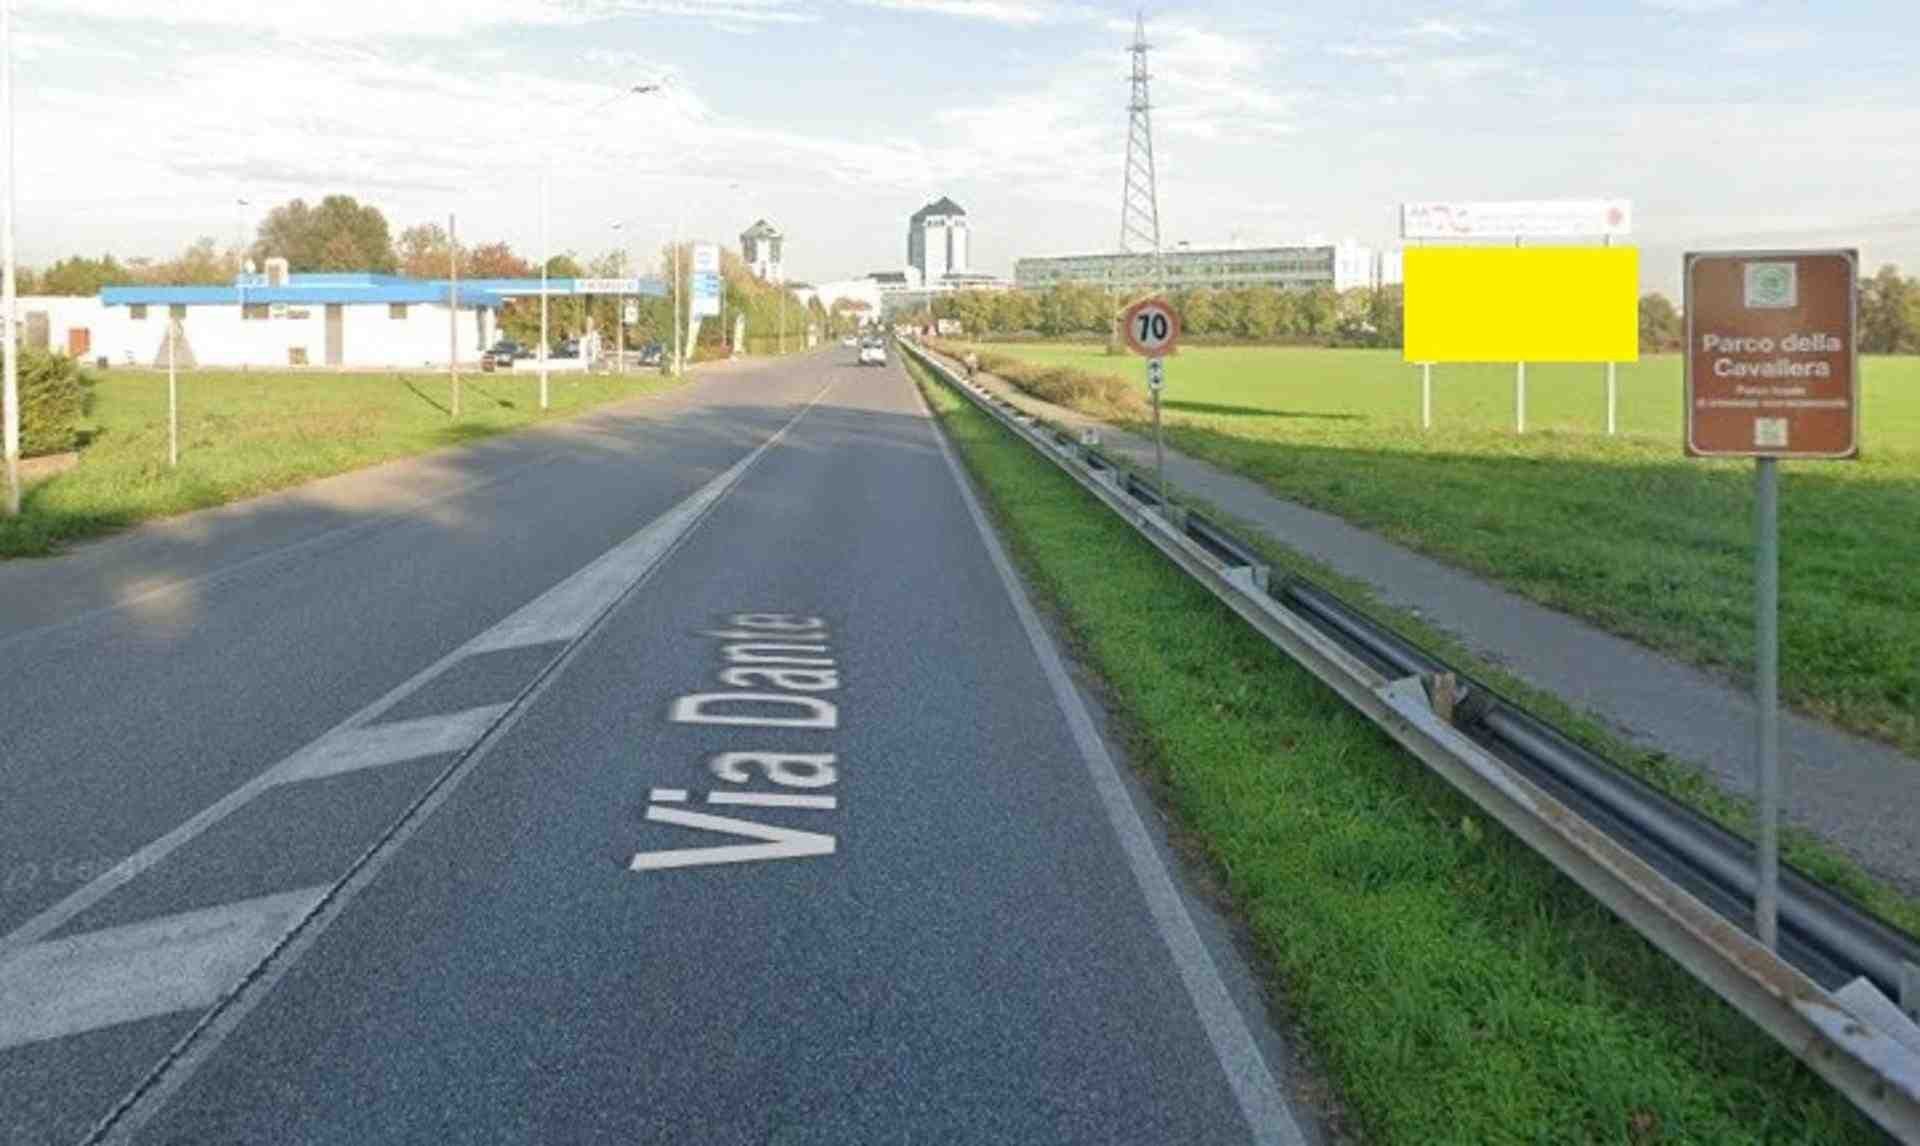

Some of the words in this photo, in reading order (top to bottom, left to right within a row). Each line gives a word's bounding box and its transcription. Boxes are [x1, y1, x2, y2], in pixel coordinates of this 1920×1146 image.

[1137, 312, 1167, 342] 70
[1702, 334, 1775, 352] Parco
[1780, 333, 1842, 352] della
